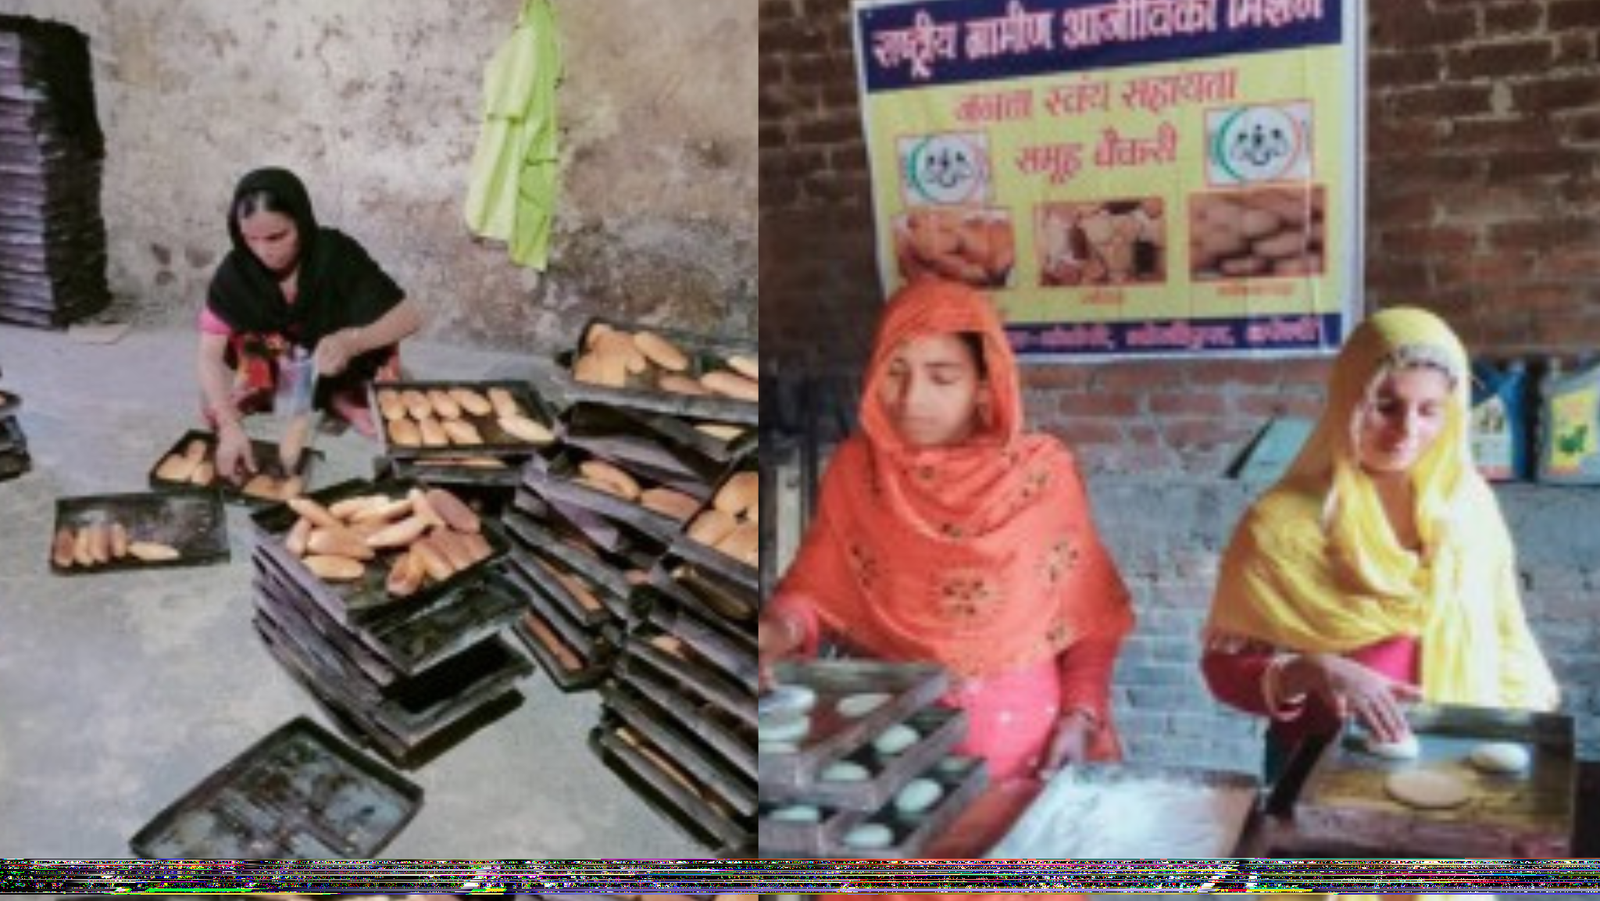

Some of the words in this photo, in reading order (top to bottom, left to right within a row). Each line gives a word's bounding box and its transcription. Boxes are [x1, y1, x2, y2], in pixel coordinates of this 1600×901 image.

[871, 9, 958, 79] राष्ट्रीय
[964, 0, 1055, 60] ग्रामीण
[1062, 0, 1216, 49] आजीविका
[1121, 67, 1237, 113] सहायता
[1016, 142, 1083, 183] समूह
